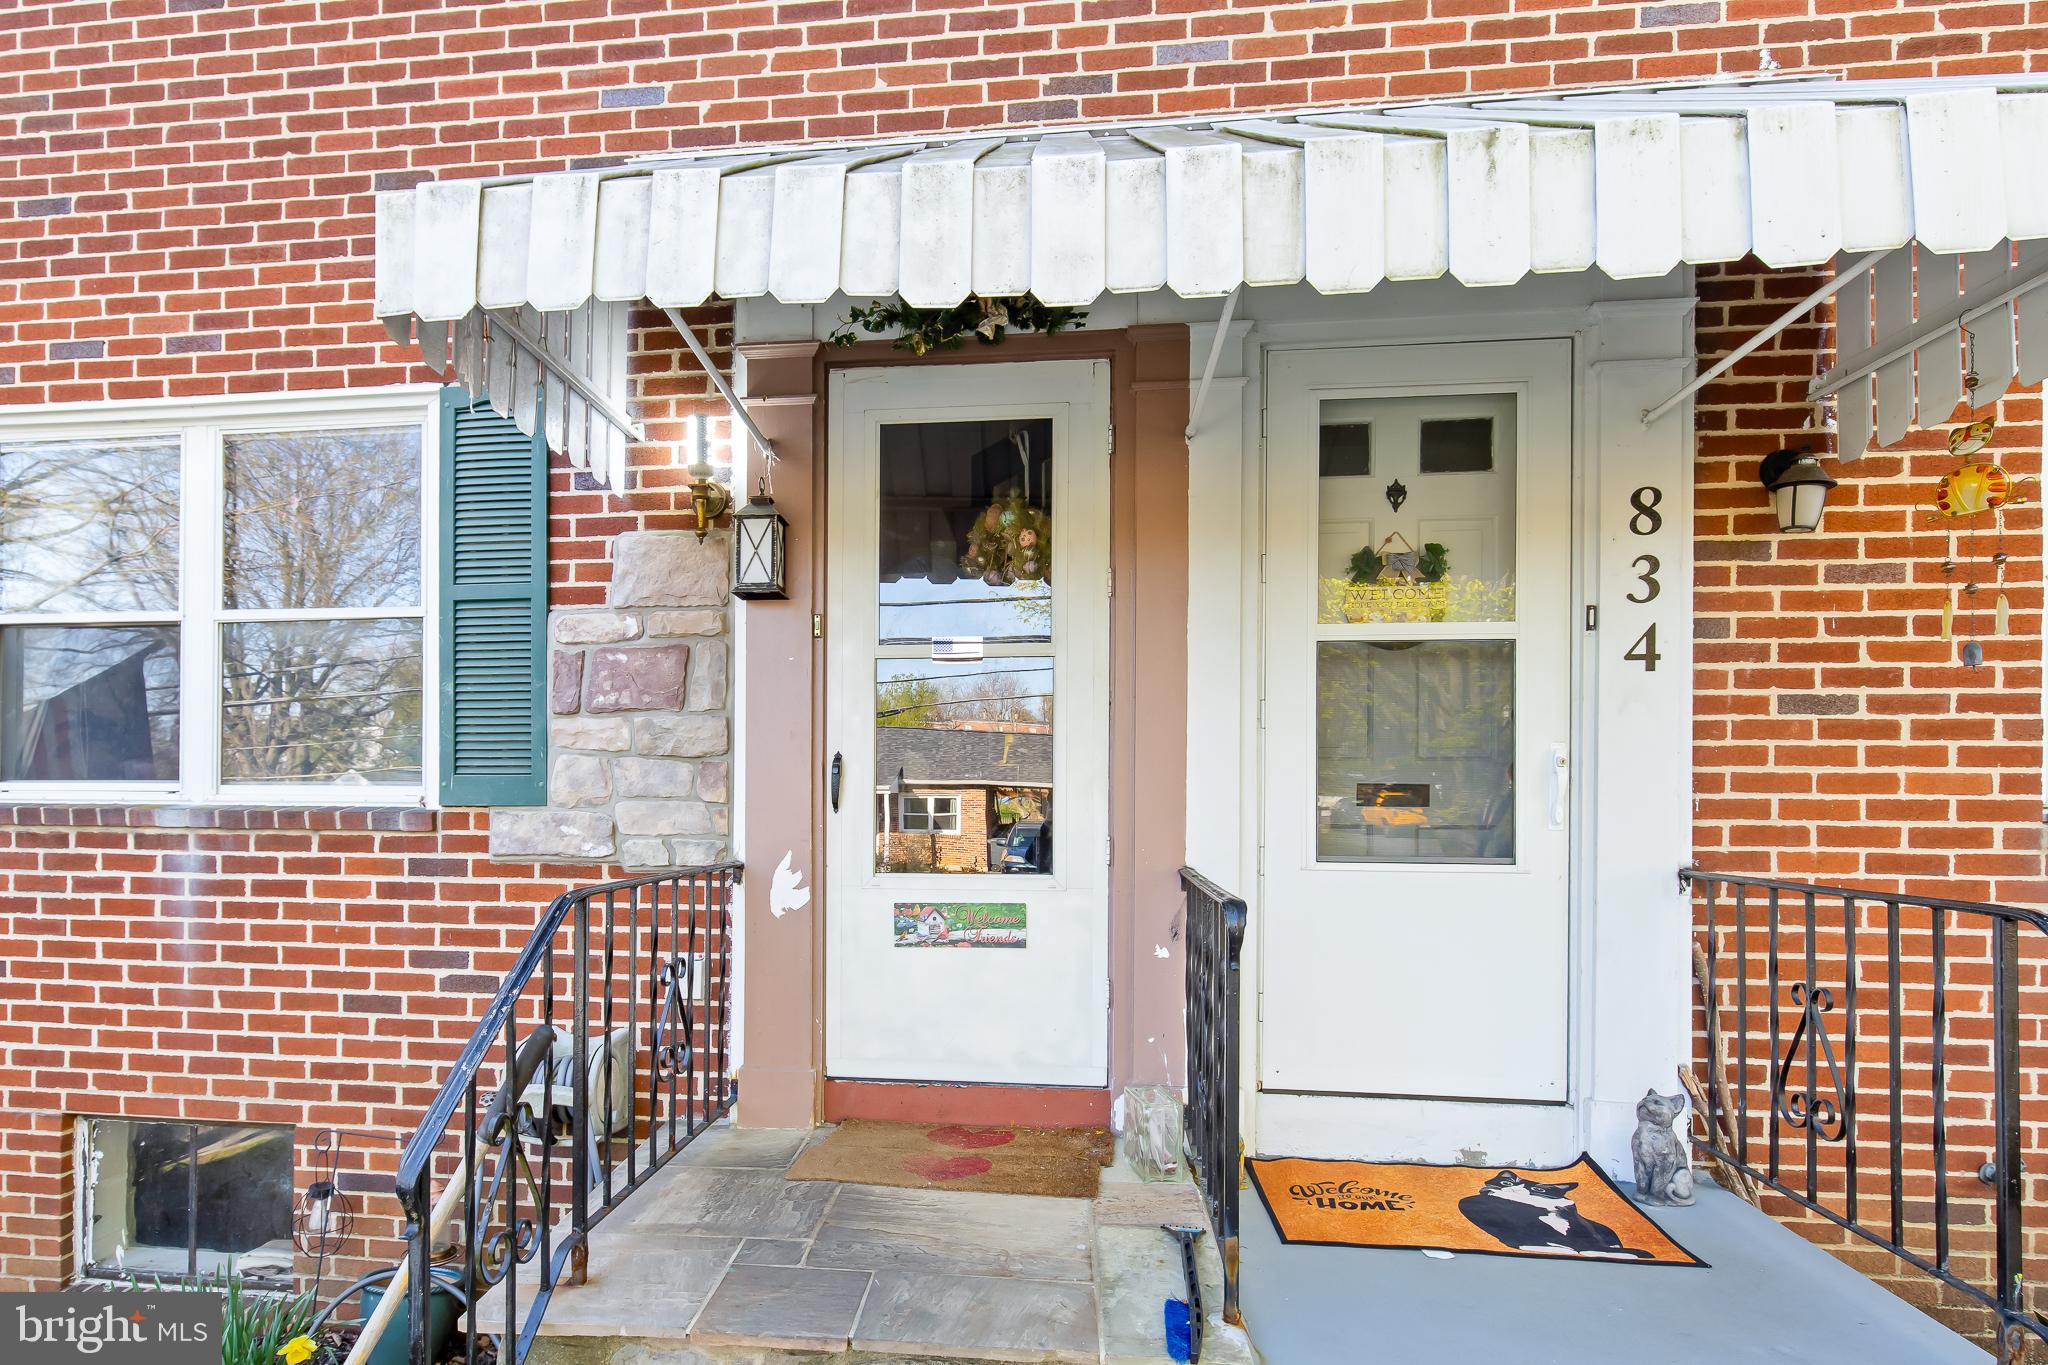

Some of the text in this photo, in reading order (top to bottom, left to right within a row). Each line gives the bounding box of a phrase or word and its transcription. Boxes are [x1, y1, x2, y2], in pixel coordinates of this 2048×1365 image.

[1624, 486, 1663, 672] 834
[1350, 588, 1444, 600] WELCOME
[955, 906, 1021, 924] Welcome
[964, 925, 1018, 943] Friends
[1289, 1181, 1412, 1200] Welcome
[1316, 1198, 1405, 1211] HOME
